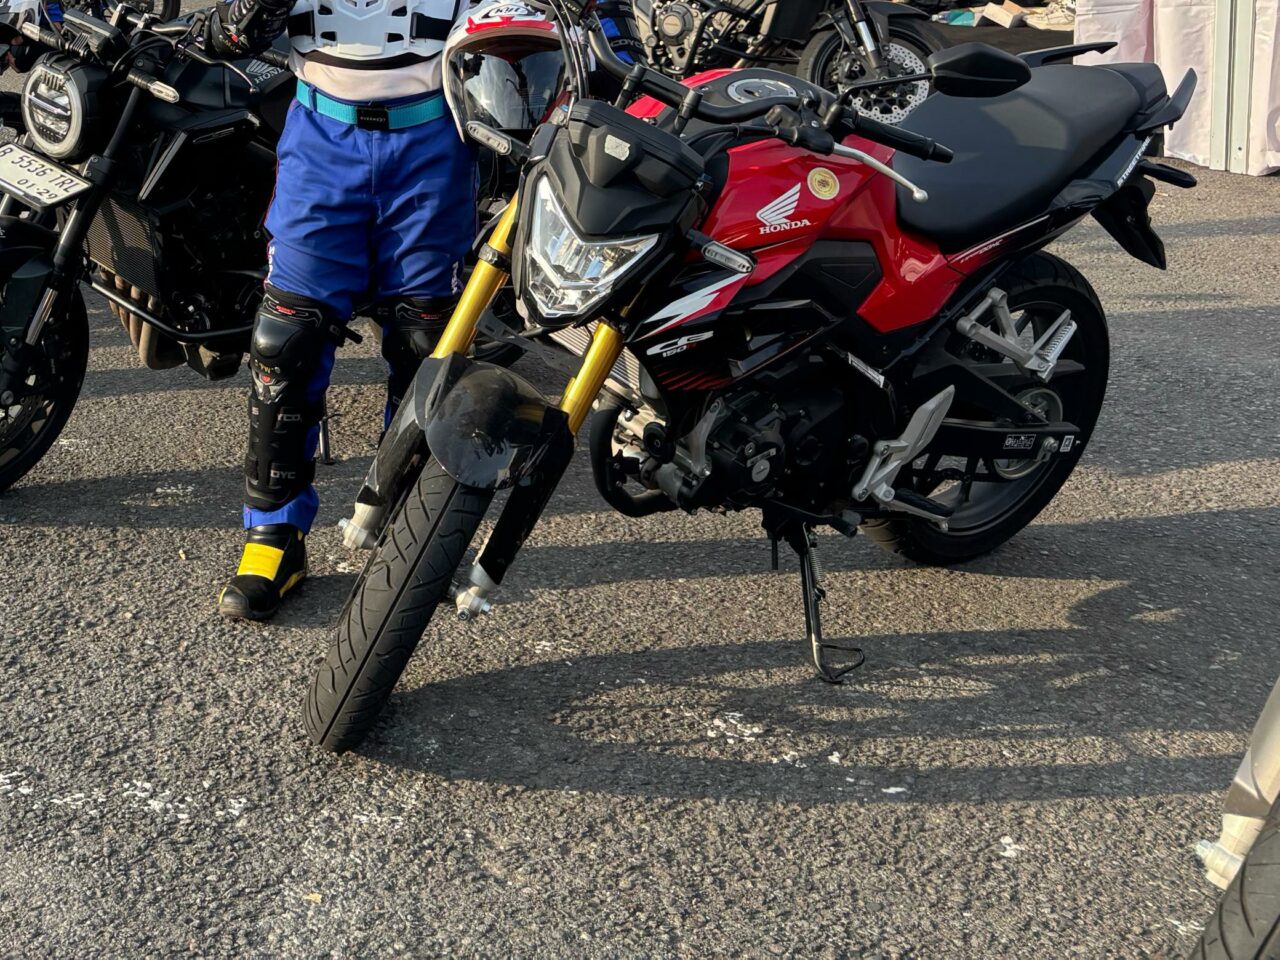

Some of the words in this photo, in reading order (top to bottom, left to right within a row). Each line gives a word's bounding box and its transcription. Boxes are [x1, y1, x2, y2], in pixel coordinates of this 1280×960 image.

[10, 154, 54, 177] 5536
[48, 173, 81, 193] TRL
[758, 218, 812, 235] HONDA
[646, 330, 714, 356] CB
